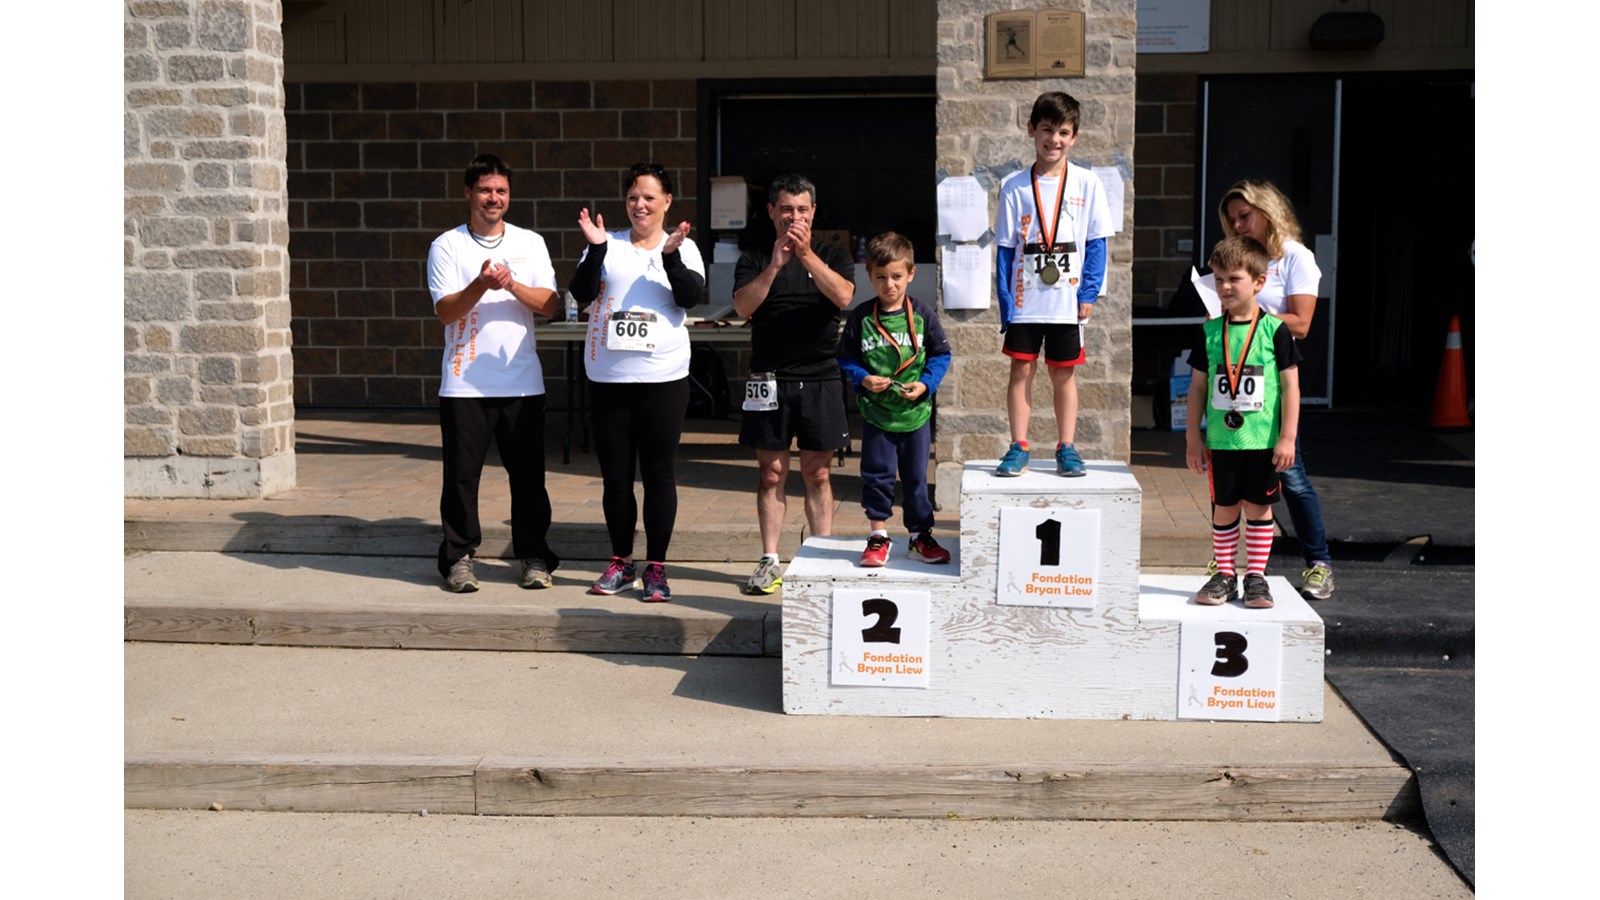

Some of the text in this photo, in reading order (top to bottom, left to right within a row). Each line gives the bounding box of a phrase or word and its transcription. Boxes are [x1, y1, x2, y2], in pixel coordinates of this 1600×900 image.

[470, 311, 479, 325] La
[615, 321, 648, 338] 606
[453, 343, 465, 377] Liew
[1218, 376, 1256, 396] 60
[1035, 518, 1061, 566] 1
[1031, 572, 1093, 585] Fondation
[1025, 583, 1093, 596] Bryan Liew
[861, 598, 902, 645] 2
[863, 652, 923, 664] Fondation
[1210, 631, 1249, 678] 3
[857, 663, 923, 675] Bryan Liew
[1213, 686, 1275, 698] Fondation
[1207, 697, 1275, 709] Bryan Liew
